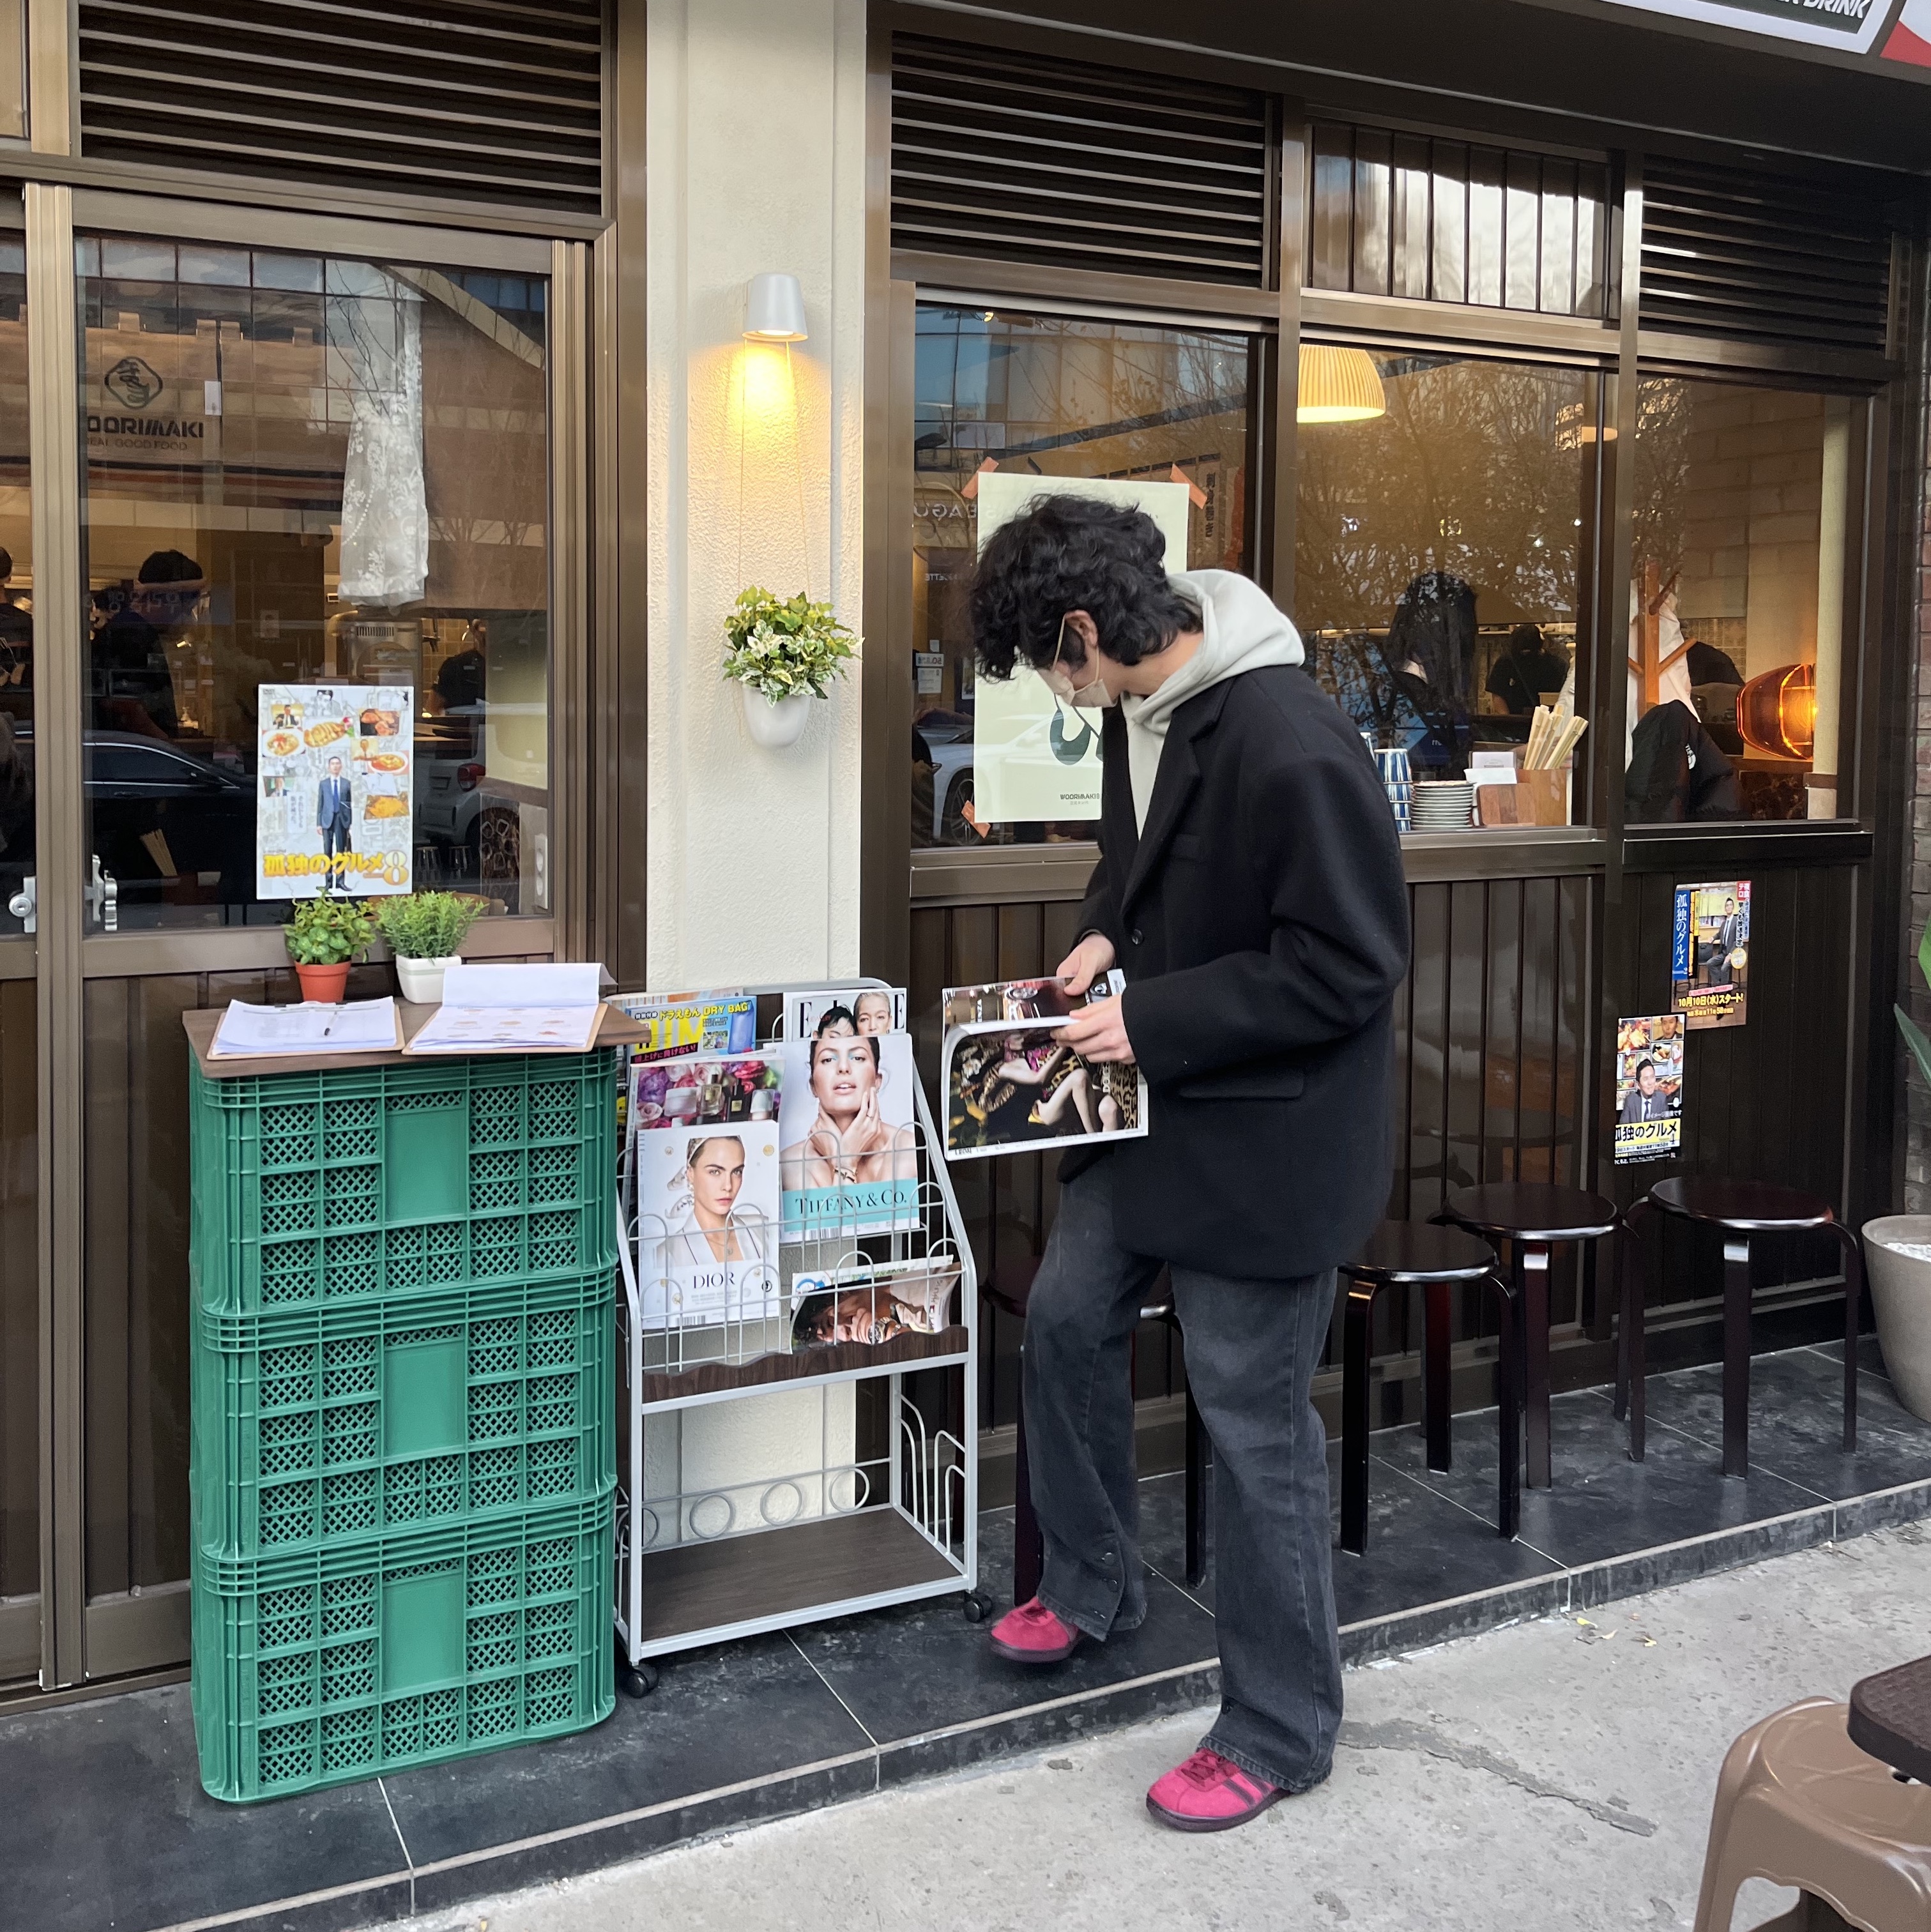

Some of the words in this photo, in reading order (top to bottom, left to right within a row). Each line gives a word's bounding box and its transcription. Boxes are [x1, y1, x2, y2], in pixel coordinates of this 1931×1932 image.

[87, 416, 204, 437] OORIMAKI
[263, 852, 384, 878] 孤独のグルメ
[383, 850, 409, 886] 8
[1675, 894, 1688, 968] 孤独のグルメ
[659, 1007, 701, 1021] ドラえもん
[703, 1005, 726, 1016] DRY
[728, 1001, 749, 1014] BAG
[800, 994, 904, 1038] EE
[693, 1272, 735, 1289] DIOR
